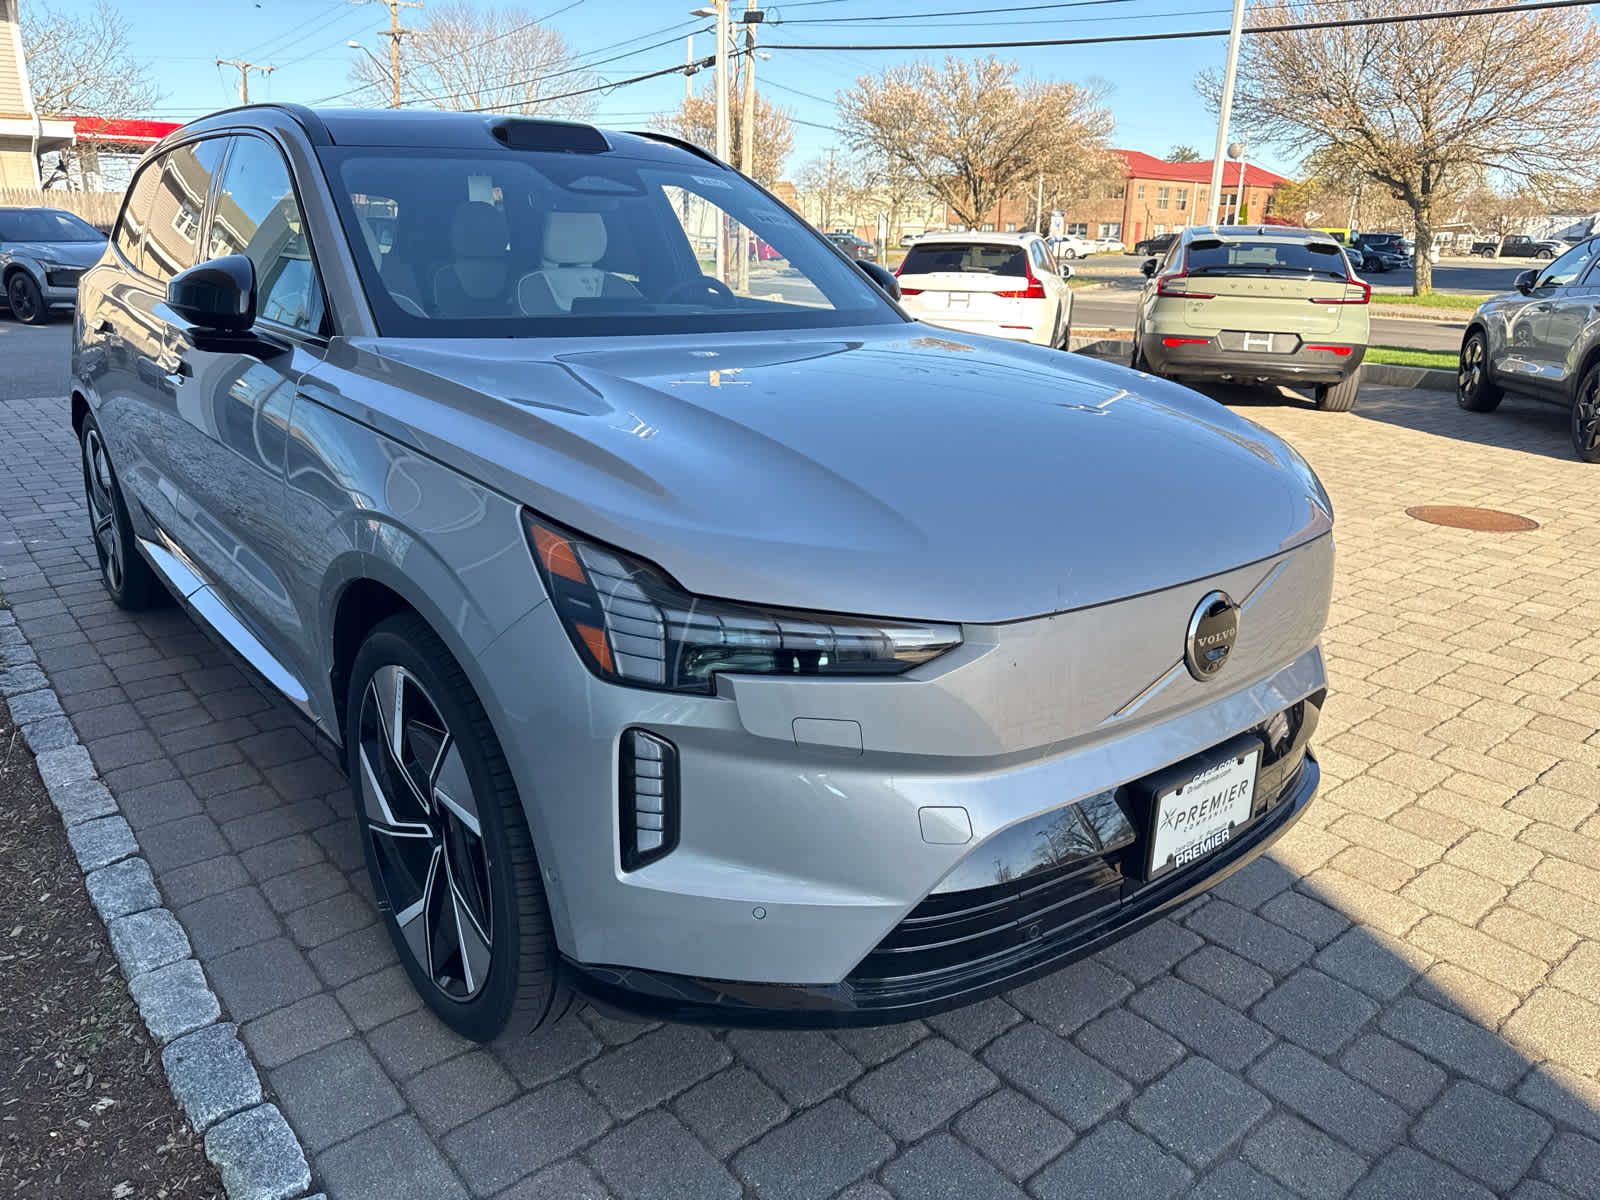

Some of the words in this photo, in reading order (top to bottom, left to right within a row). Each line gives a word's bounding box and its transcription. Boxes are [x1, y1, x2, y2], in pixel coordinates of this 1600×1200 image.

[1198, 627, 1236, 647] VOLVO
[1174, 779, 1249, 831] PREMIER
[1183, 803, 1233, 832] COMPANIES
[1176, 829, 1230, 868] PREMIER
